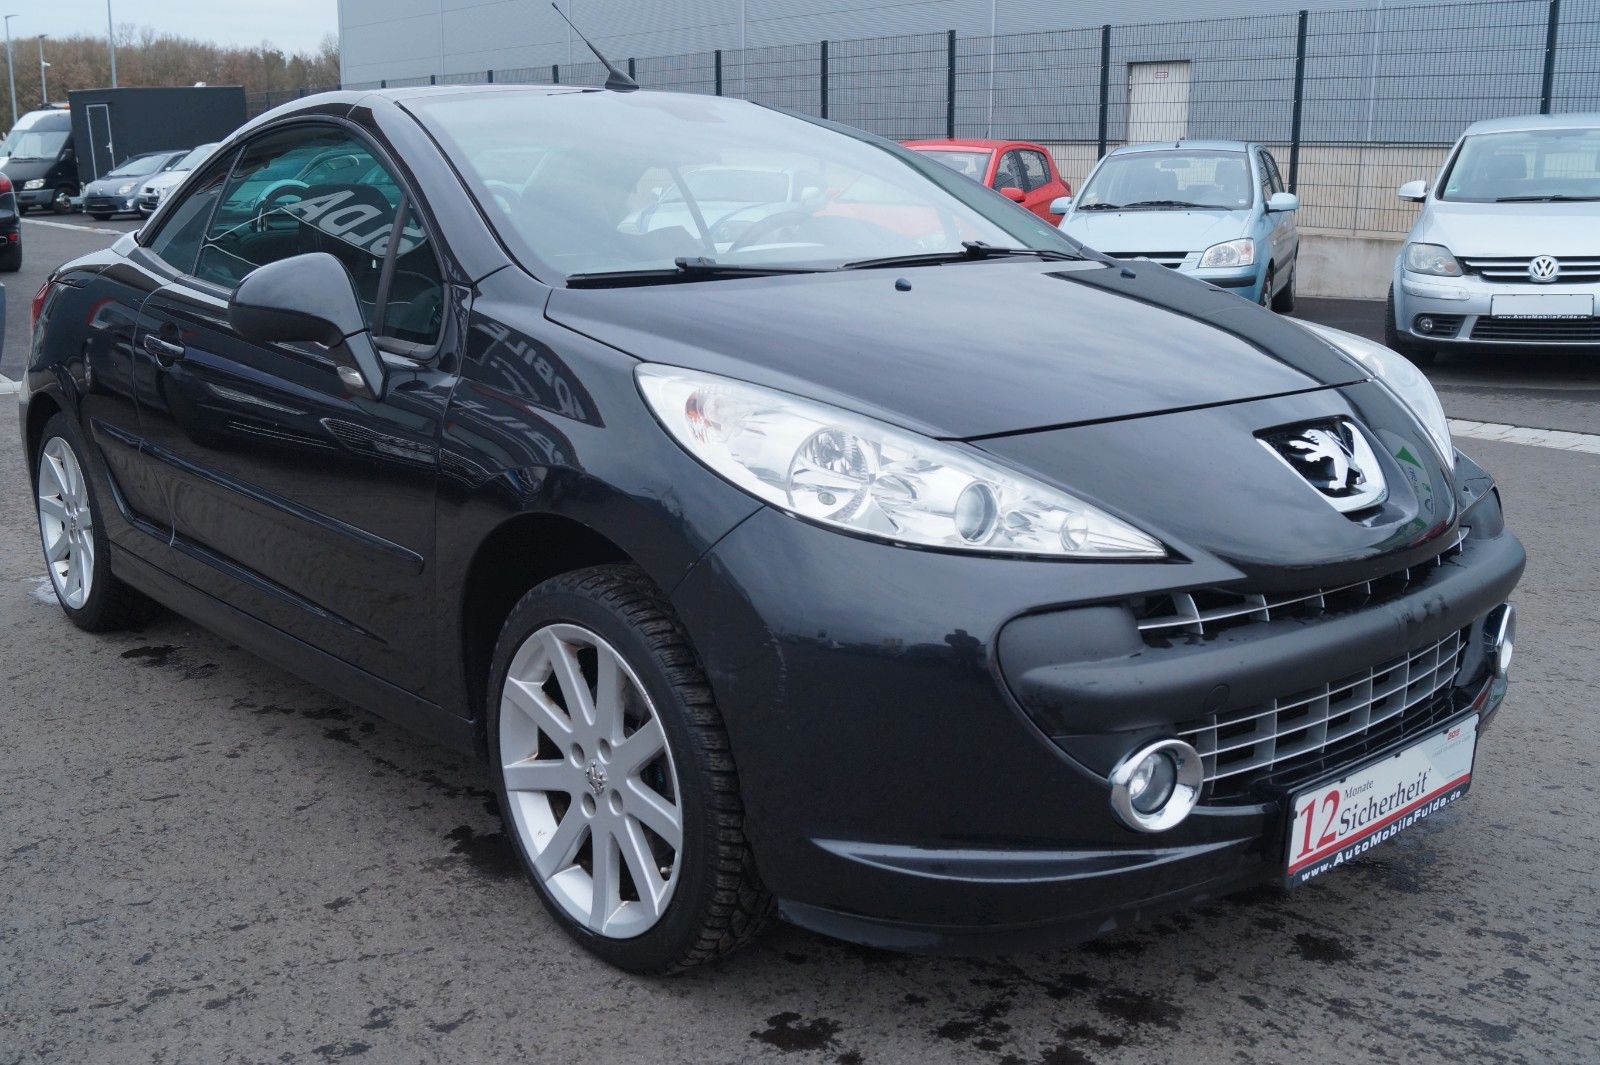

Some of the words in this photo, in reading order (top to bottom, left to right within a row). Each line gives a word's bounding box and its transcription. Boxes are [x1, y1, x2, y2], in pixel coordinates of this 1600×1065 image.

[1297, 789, 1340, 860] 12
[1344, 779, 1374, 800] Monate
[1301, 790, 1461, 882] www.AutoMobileFulda.de
